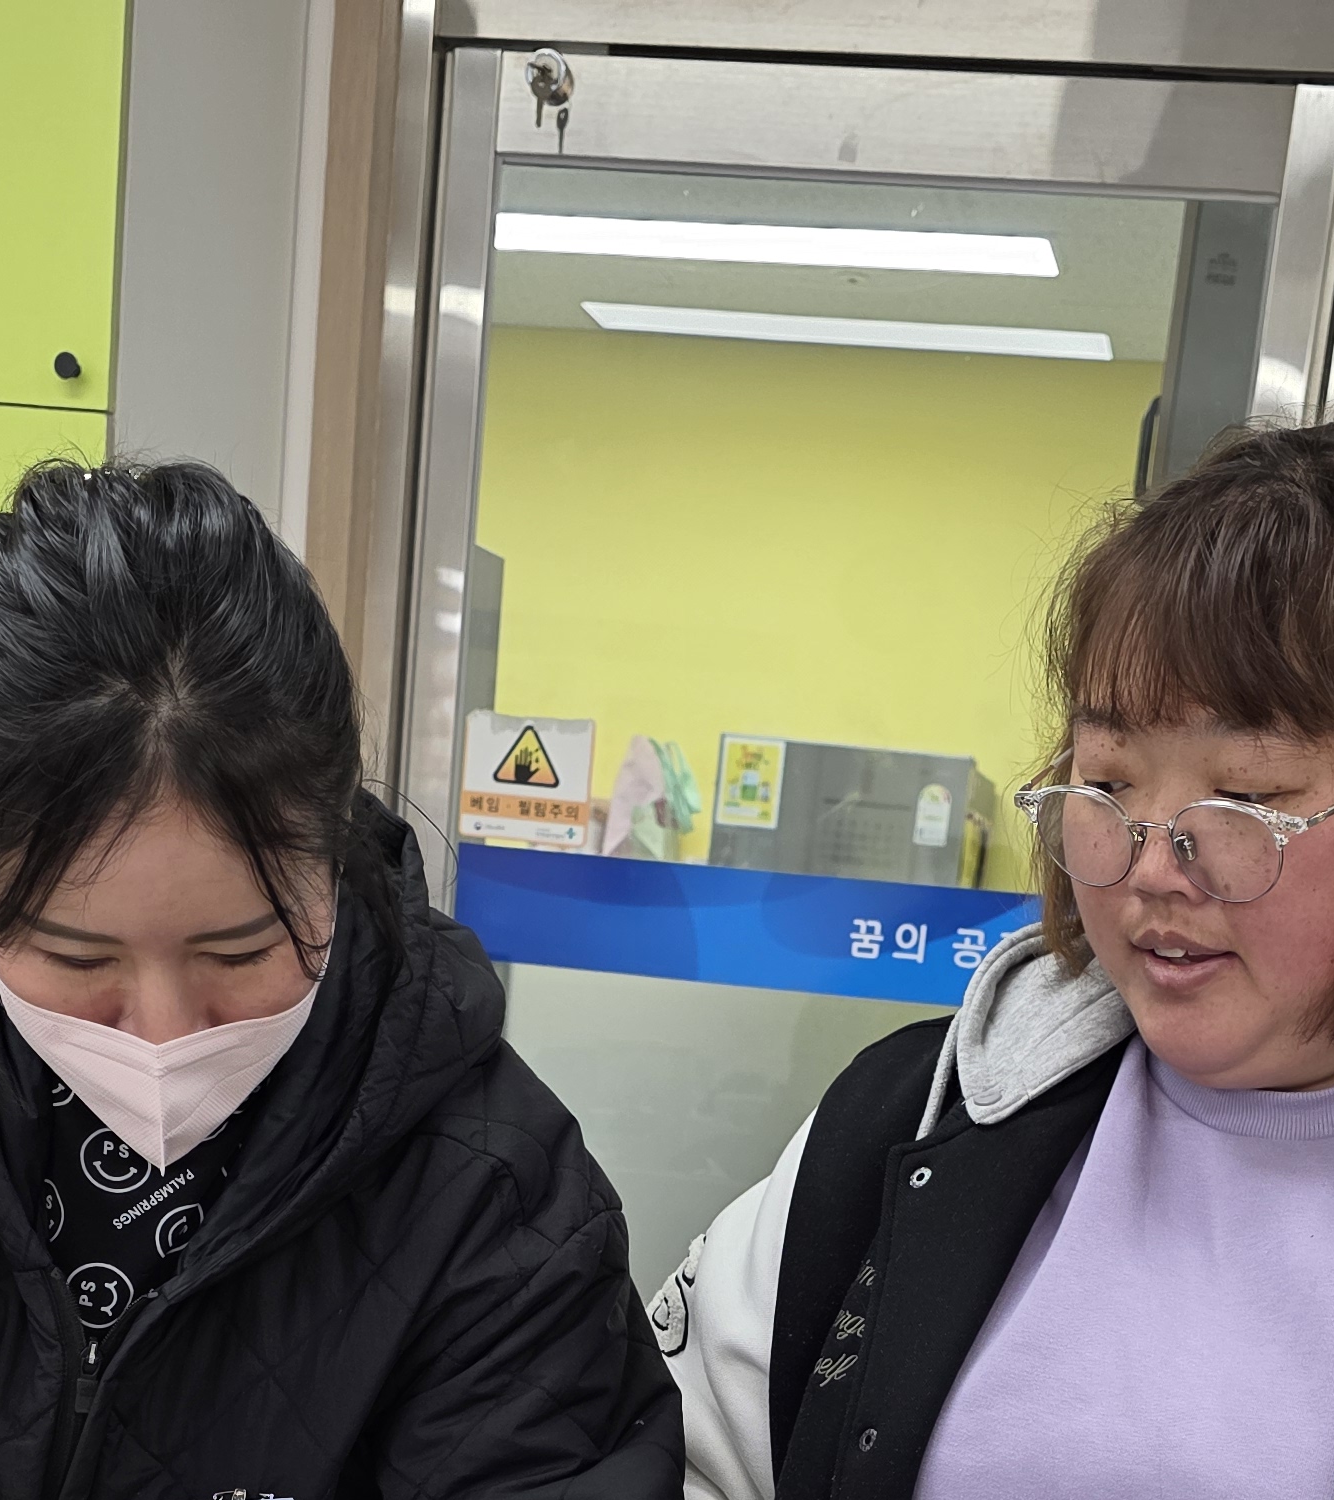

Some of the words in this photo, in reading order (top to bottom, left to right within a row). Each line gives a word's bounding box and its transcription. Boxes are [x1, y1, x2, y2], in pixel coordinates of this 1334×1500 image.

[850, 919, 927, 964] 꿈의
[952, 927, 1013, 969] 공
[112, 1168, 195, 1230] PALMSPRINGS
